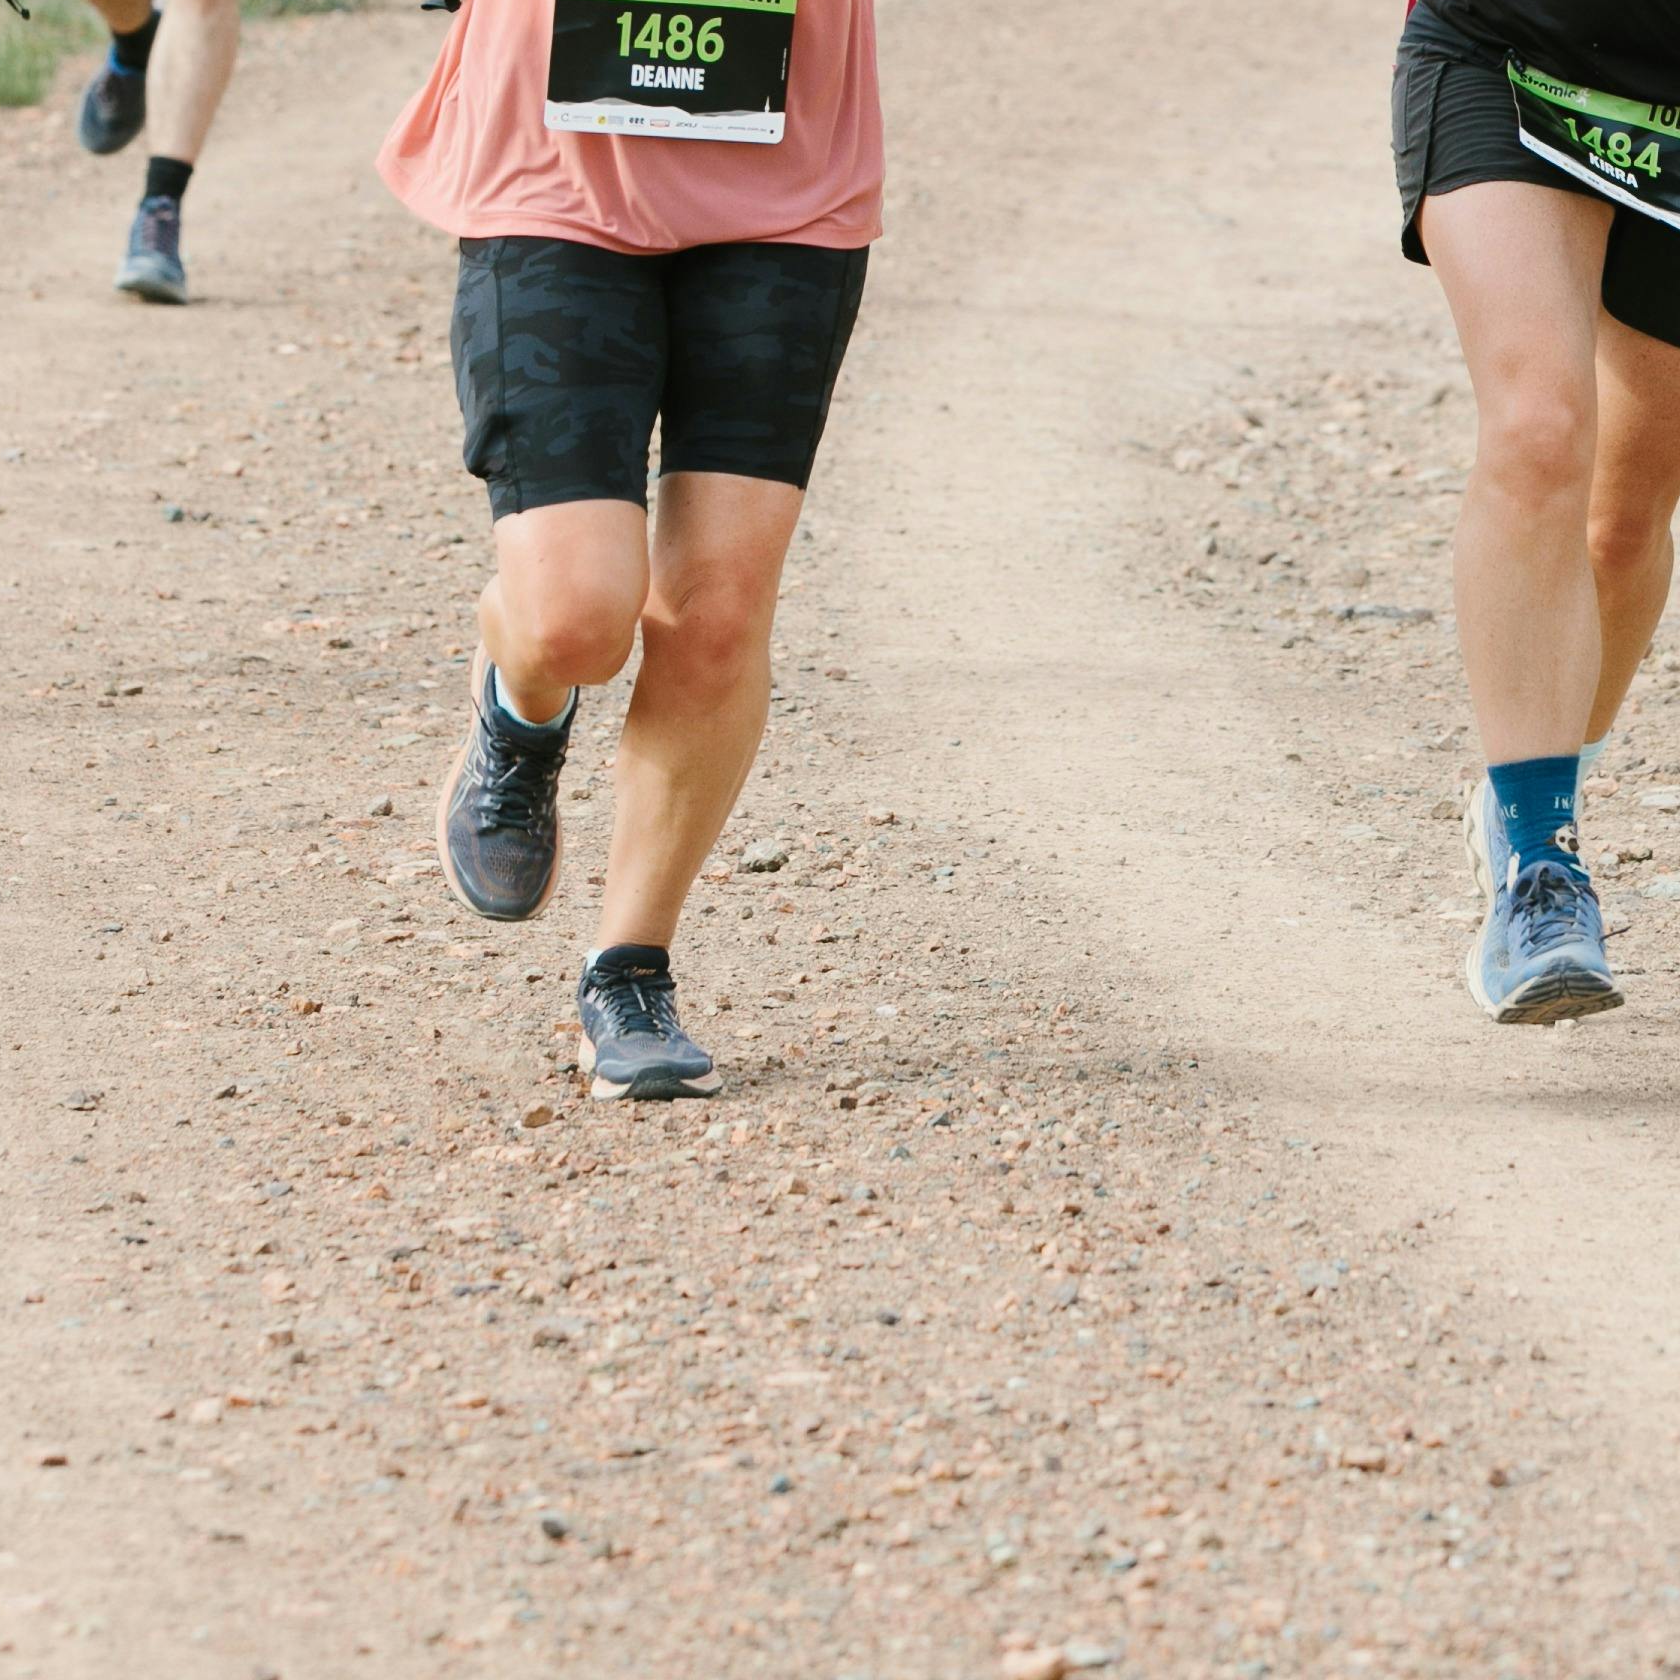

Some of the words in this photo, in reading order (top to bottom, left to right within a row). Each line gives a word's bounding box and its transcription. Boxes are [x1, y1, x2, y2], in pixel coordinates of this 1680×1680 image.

[616, 11, 725, 63] 1486
[630, 64, 706, 91] DEANNE
[1589, 152, 1639, 189] KIRRA
